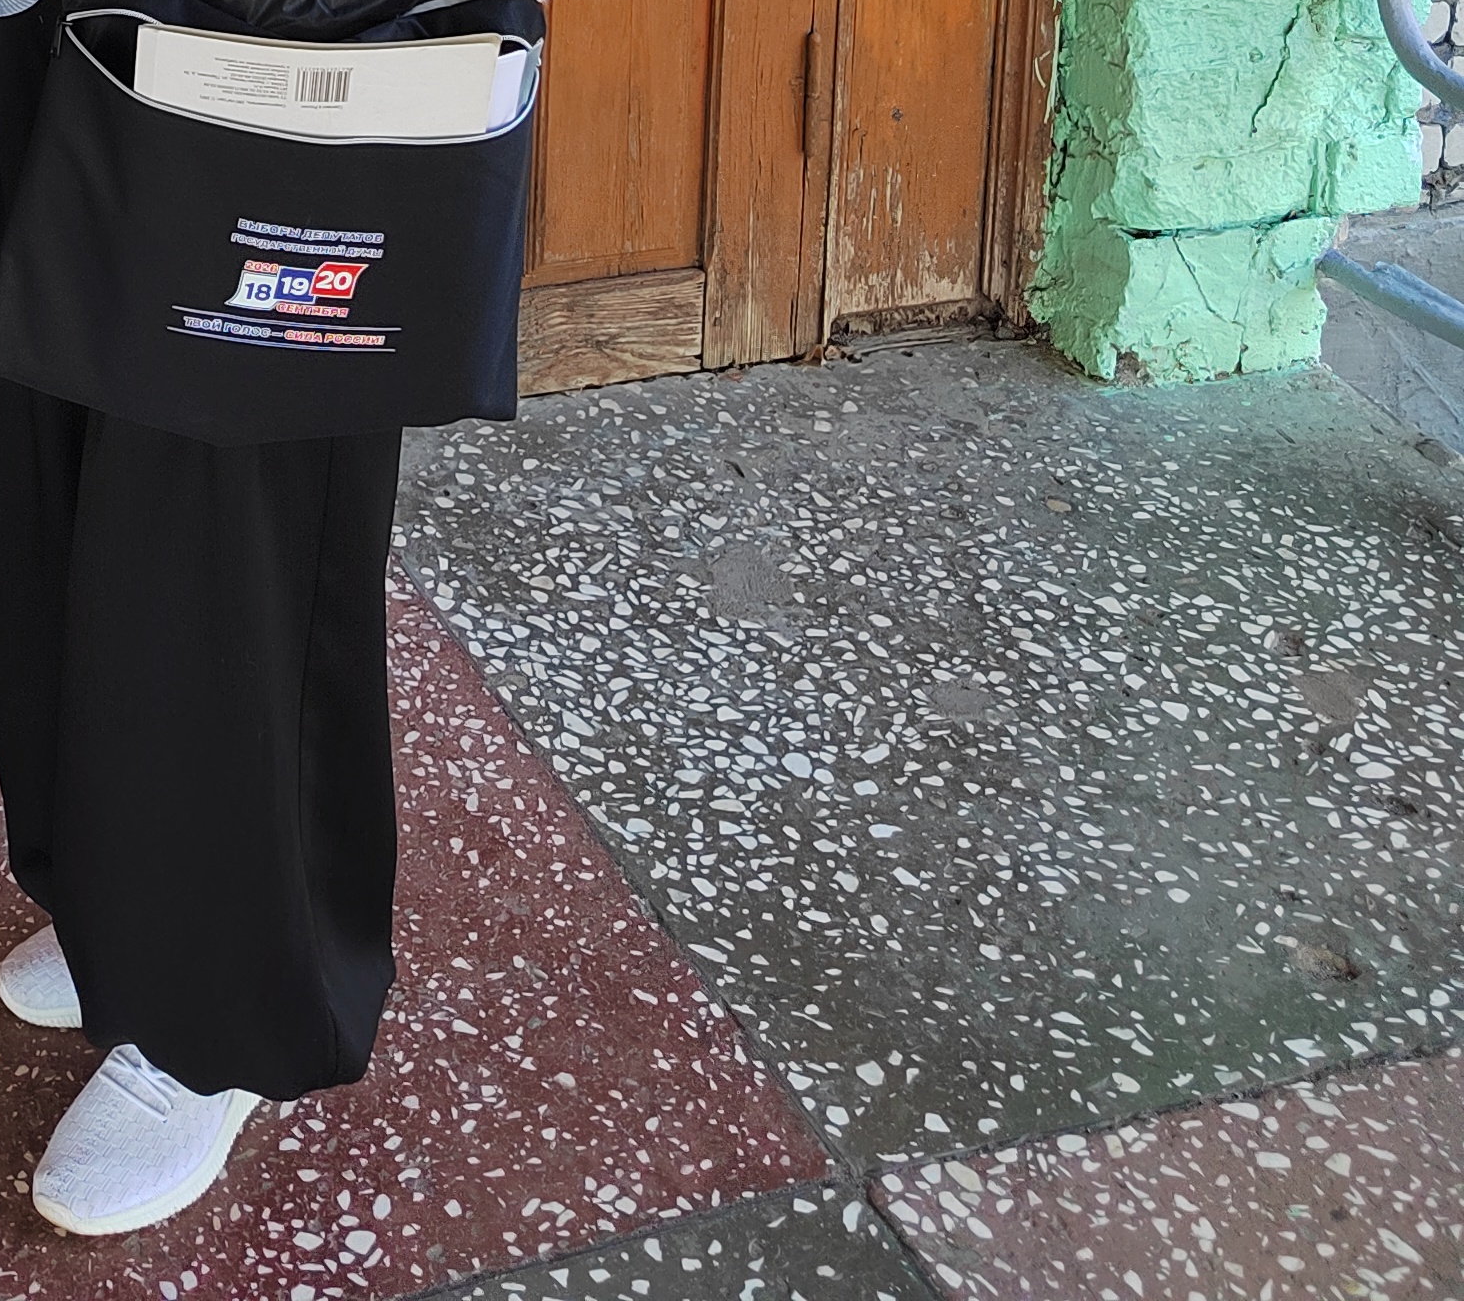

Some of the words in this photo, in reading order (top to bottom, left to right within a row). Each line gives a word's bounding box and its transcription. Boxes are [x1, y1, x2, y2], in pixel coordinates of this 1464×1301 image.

[237, 217, 301, 239] ВЫБОРЫ
[301, 228, 384, 244] ДЕПУТАТОВ
[243, 259, 279, 273] 2026
[244, 282, 272, 301] 18
[280, 276, 309, 295] 19
[315, 270, 353, 290] 20
[275, 302, 350, 318] СЕНТЯБРЯ
[182, 315, 222, 333] ТВОЙ
[222, 321, 271, 338] ГОЛОС
[283, 329, 323, 343] СИЛА
